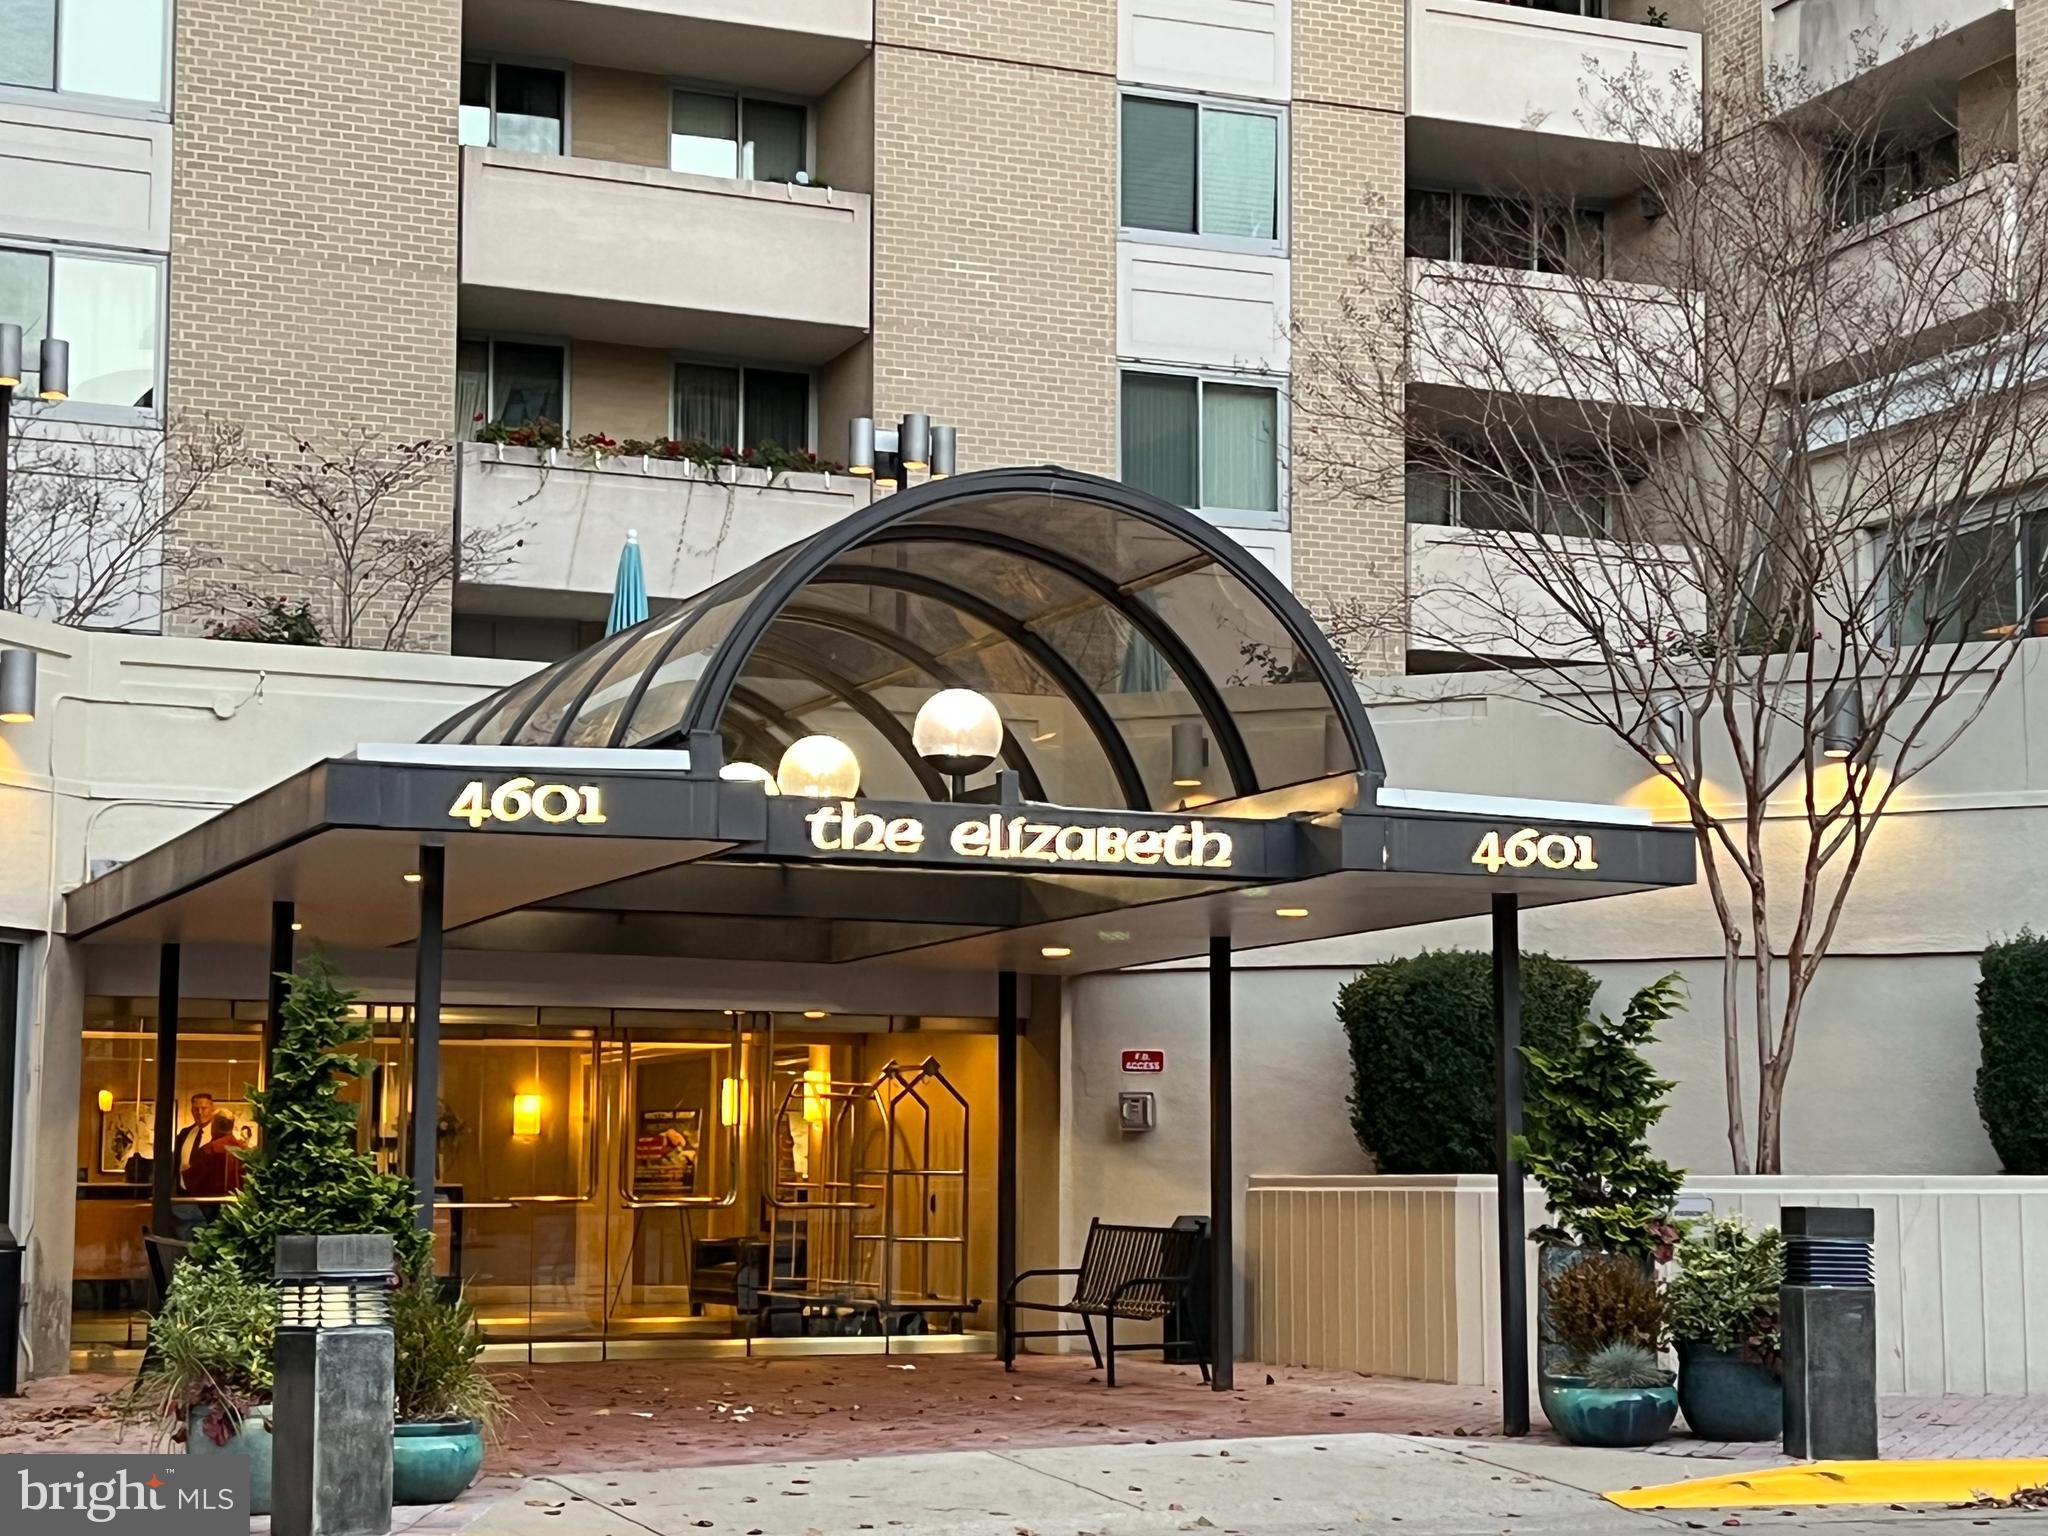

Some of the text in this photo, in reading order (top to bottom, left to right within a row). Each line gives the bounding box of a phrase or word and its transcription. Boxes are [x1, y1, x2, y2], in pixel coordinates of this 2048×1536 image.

[447, 776, 608, 829] 4601
[804, 801, 926, 853] the
[1471, 827, 1599, 874] 4601
[1125, 1061, 1160, 1071] ACCESS
